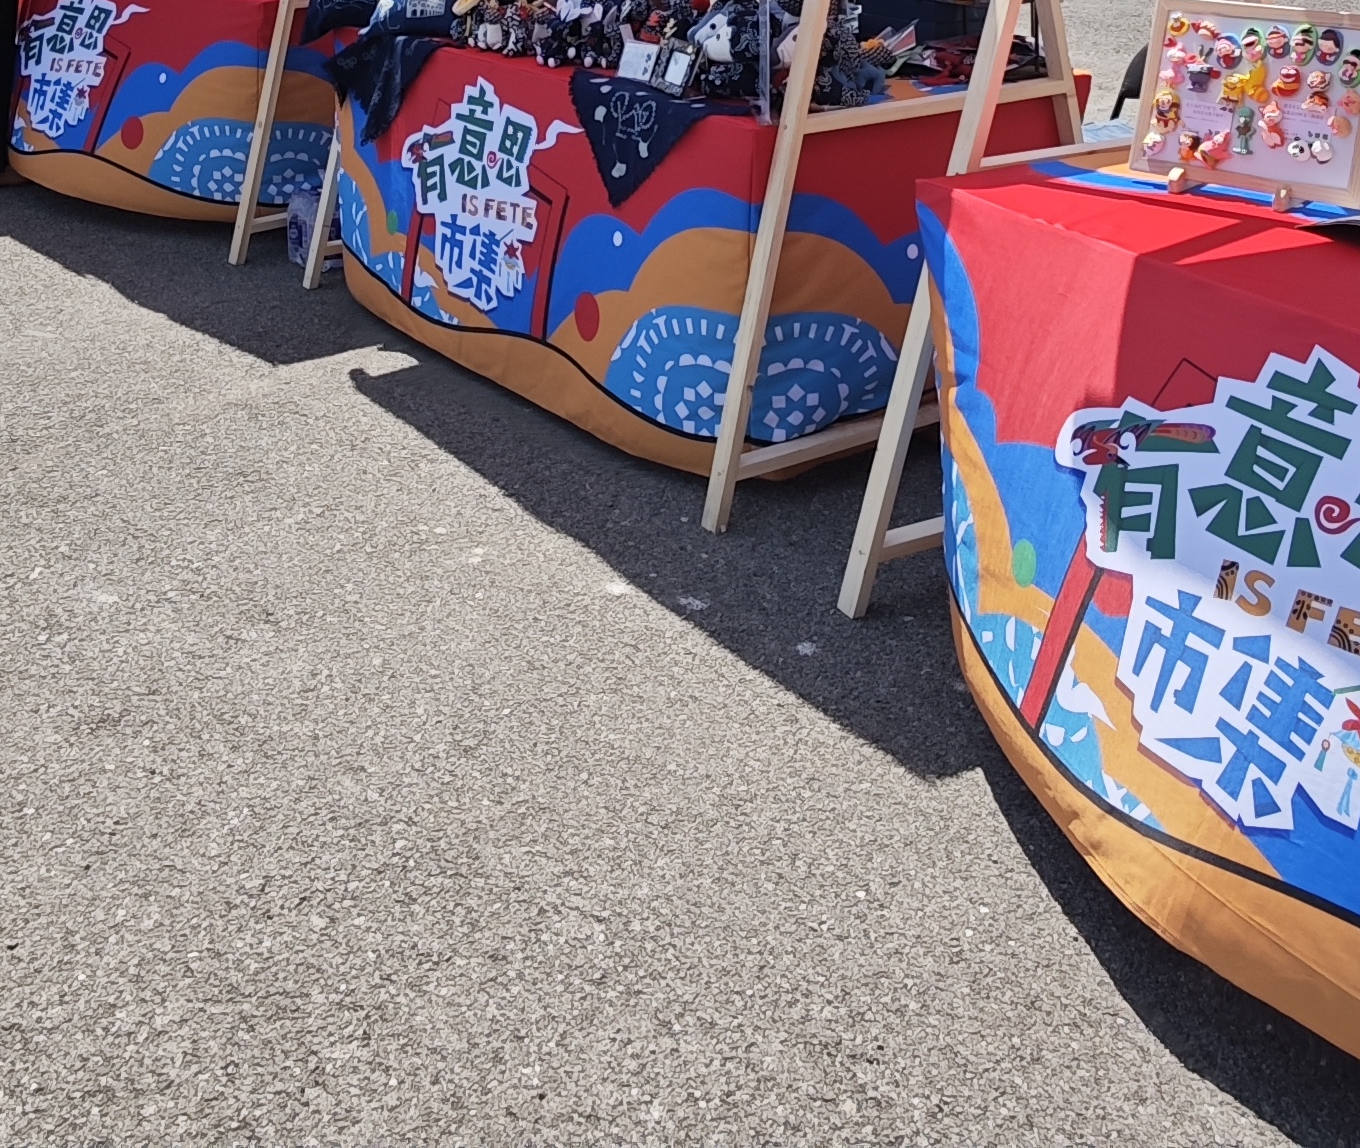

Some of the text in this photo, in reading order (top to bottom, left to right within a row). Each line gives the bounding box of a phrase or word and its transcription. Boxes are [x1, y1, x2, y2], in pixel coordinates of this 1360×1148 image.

[49, 57, 104, 78] IS FETE
[408, 83, 533, 205] 有意思
[461, 193, 534, 230] IS FETE
[1214, 560, 1276, 617] IS
